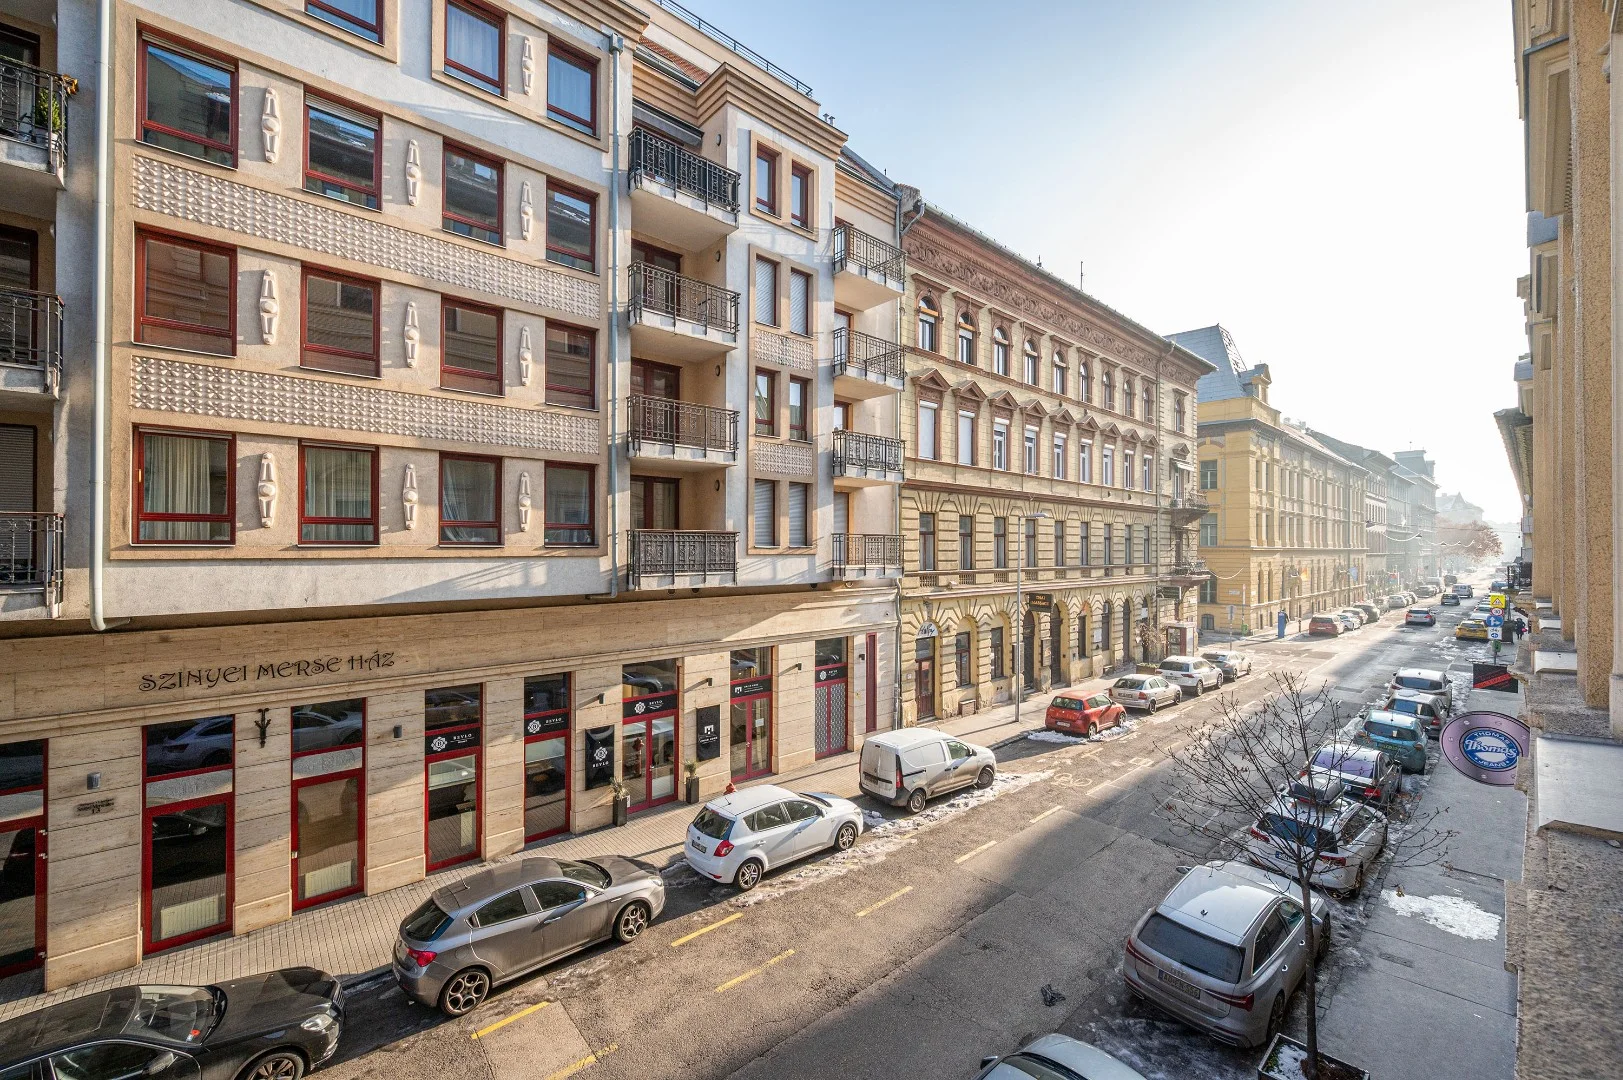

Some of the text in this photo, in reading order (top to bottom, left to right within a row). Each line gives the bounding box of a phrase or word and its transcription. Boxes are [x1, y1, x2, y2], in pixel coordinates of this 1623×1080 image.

[138, 650, 395, 692] SZINYEI MERSE HÁZ
[1464, 739, 1517, 758] Thomas
